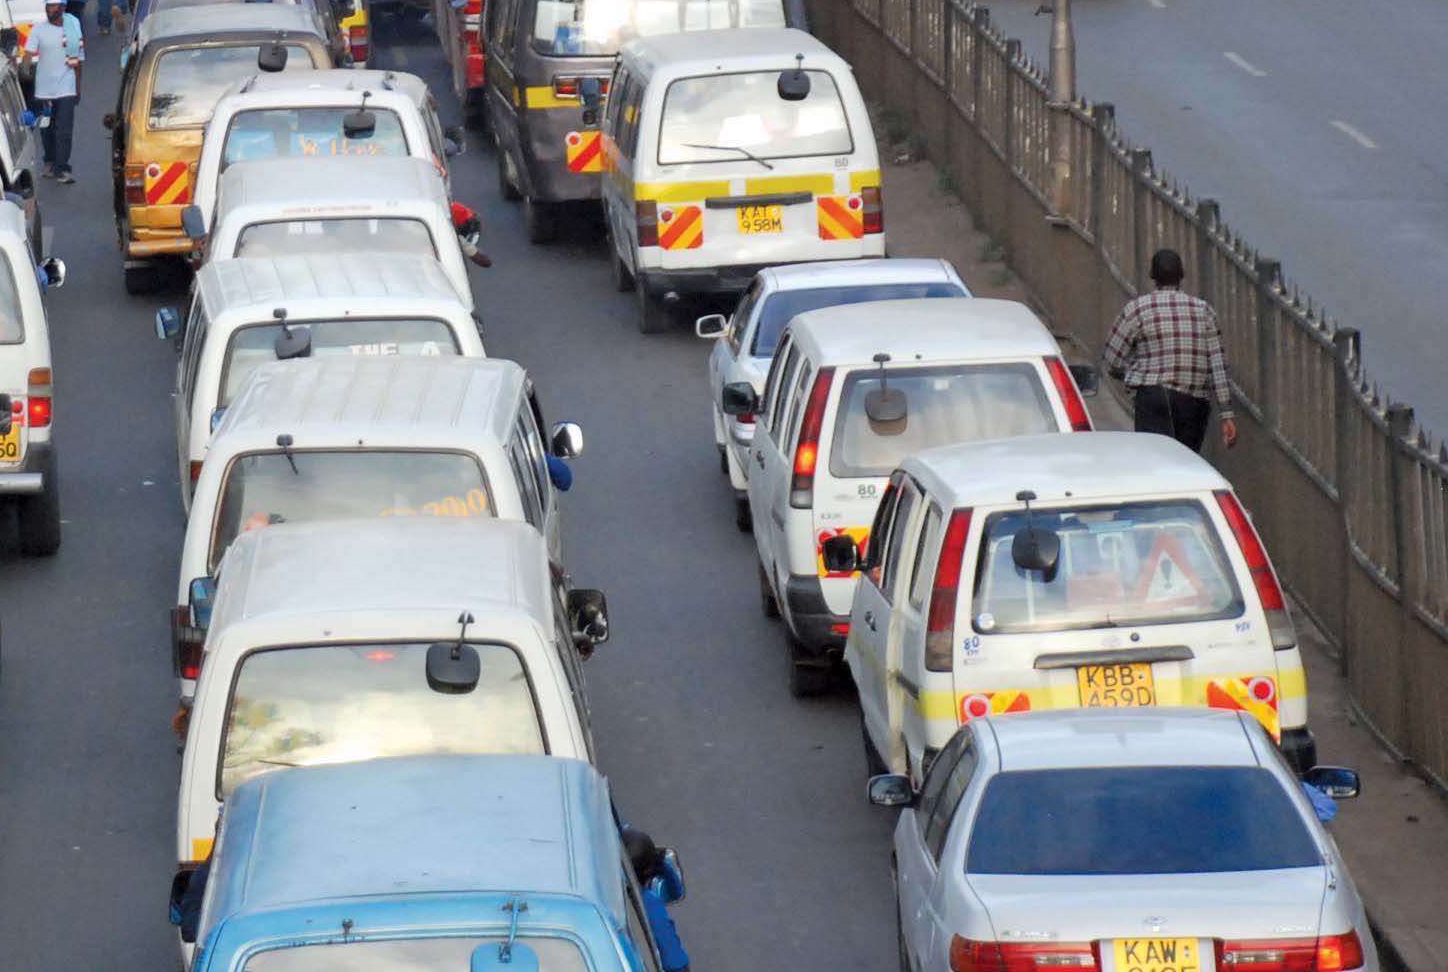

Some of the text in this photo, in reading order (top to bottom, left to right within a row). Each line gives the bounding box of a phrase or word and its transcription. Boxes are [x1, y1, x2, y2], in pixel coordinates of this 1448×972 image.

[740, 205, 769, 219] KAT
[741, 218, 783, 234] 958M
[857, 483, 876, 496] 80
[963, 635, 980, 650] 80
[1085, 666, 1135, 688] KBB
[1088, 687, 1152, 707] 459D
[1124, 939, 1177, 965] KAW
